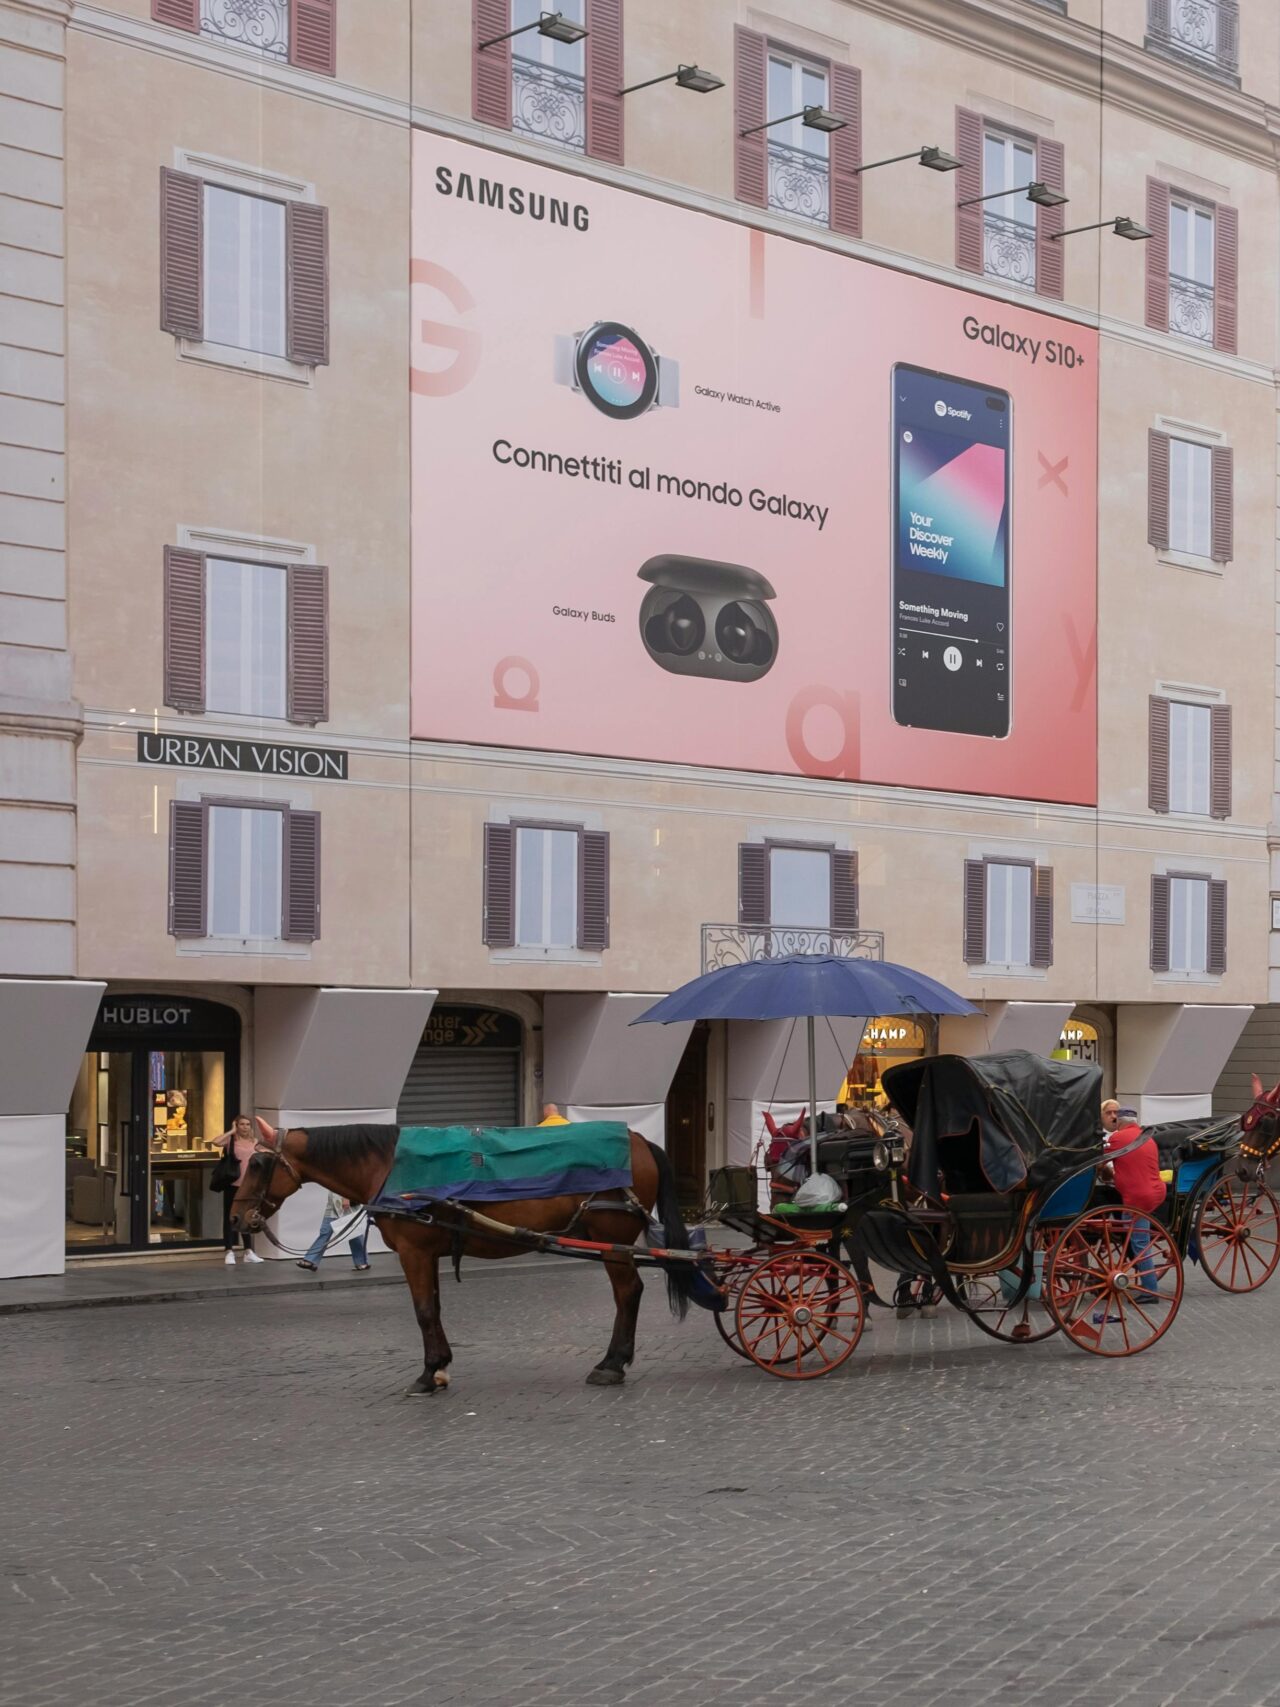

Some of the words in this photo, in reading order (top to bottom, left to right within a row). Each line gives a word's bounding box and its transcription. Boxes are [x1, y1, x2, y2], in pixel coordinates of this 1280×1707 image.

[435, 166, 590, 232] SAMSUNG
[962, 316, 1042, 365] Galaxy
[1045, 340, 1085, 369] S10+
[694, 385, 726, 403] Galaxy
[727, 391, 754, 408] Watch
[755, 399, 782, 413] Active
[947, 406, 972, 421] Spotify
[492, 439, 622, 485] Connettiti
[628, 466, 650, 491] al
[657, 472, 743, 507] mondo
[749, 488, 829, 531] Galaxy
[909, 511, 933, 528] Your
[909, 527, 954, 547] Discover
[909, 541, 949, 565] Weekly
[552, 605, 589, 622] Galaxy
[591, 609, 616, 623] Buds
[899, 600, 940, 618] Something
[940, 607, 969, 622] Moving
[143, 736, 240, 769] URBAN
[251, 746, 344, 778] VISION
[103, 1007, 192, 1025] HUBLOT
